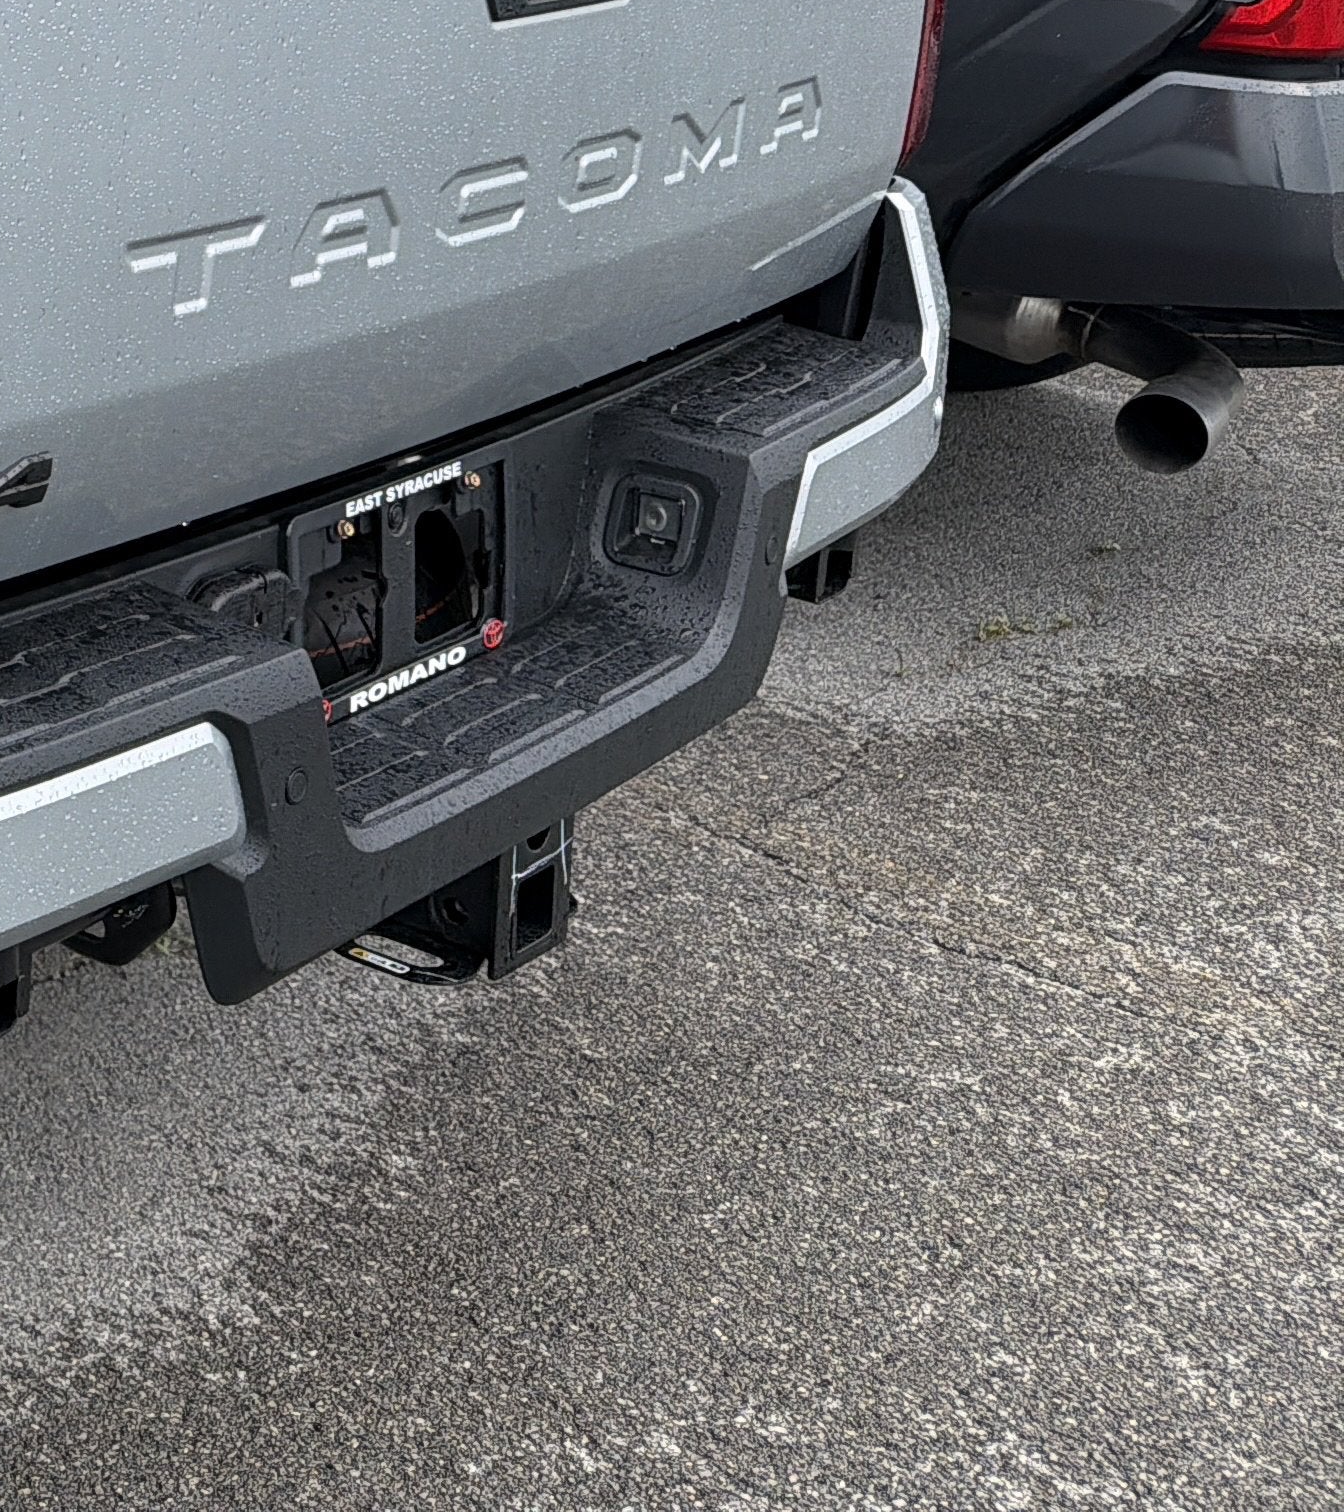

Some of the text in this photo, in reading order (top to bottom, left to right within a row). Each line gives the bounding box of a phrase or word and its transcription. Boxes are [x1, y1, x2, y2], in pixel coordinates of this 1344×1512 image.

[125, 75, 824, 316] TACOMA
[345, 461, 463, 518] EAST SYRACUSE
[349, 646, 467, 713] ROMANO
